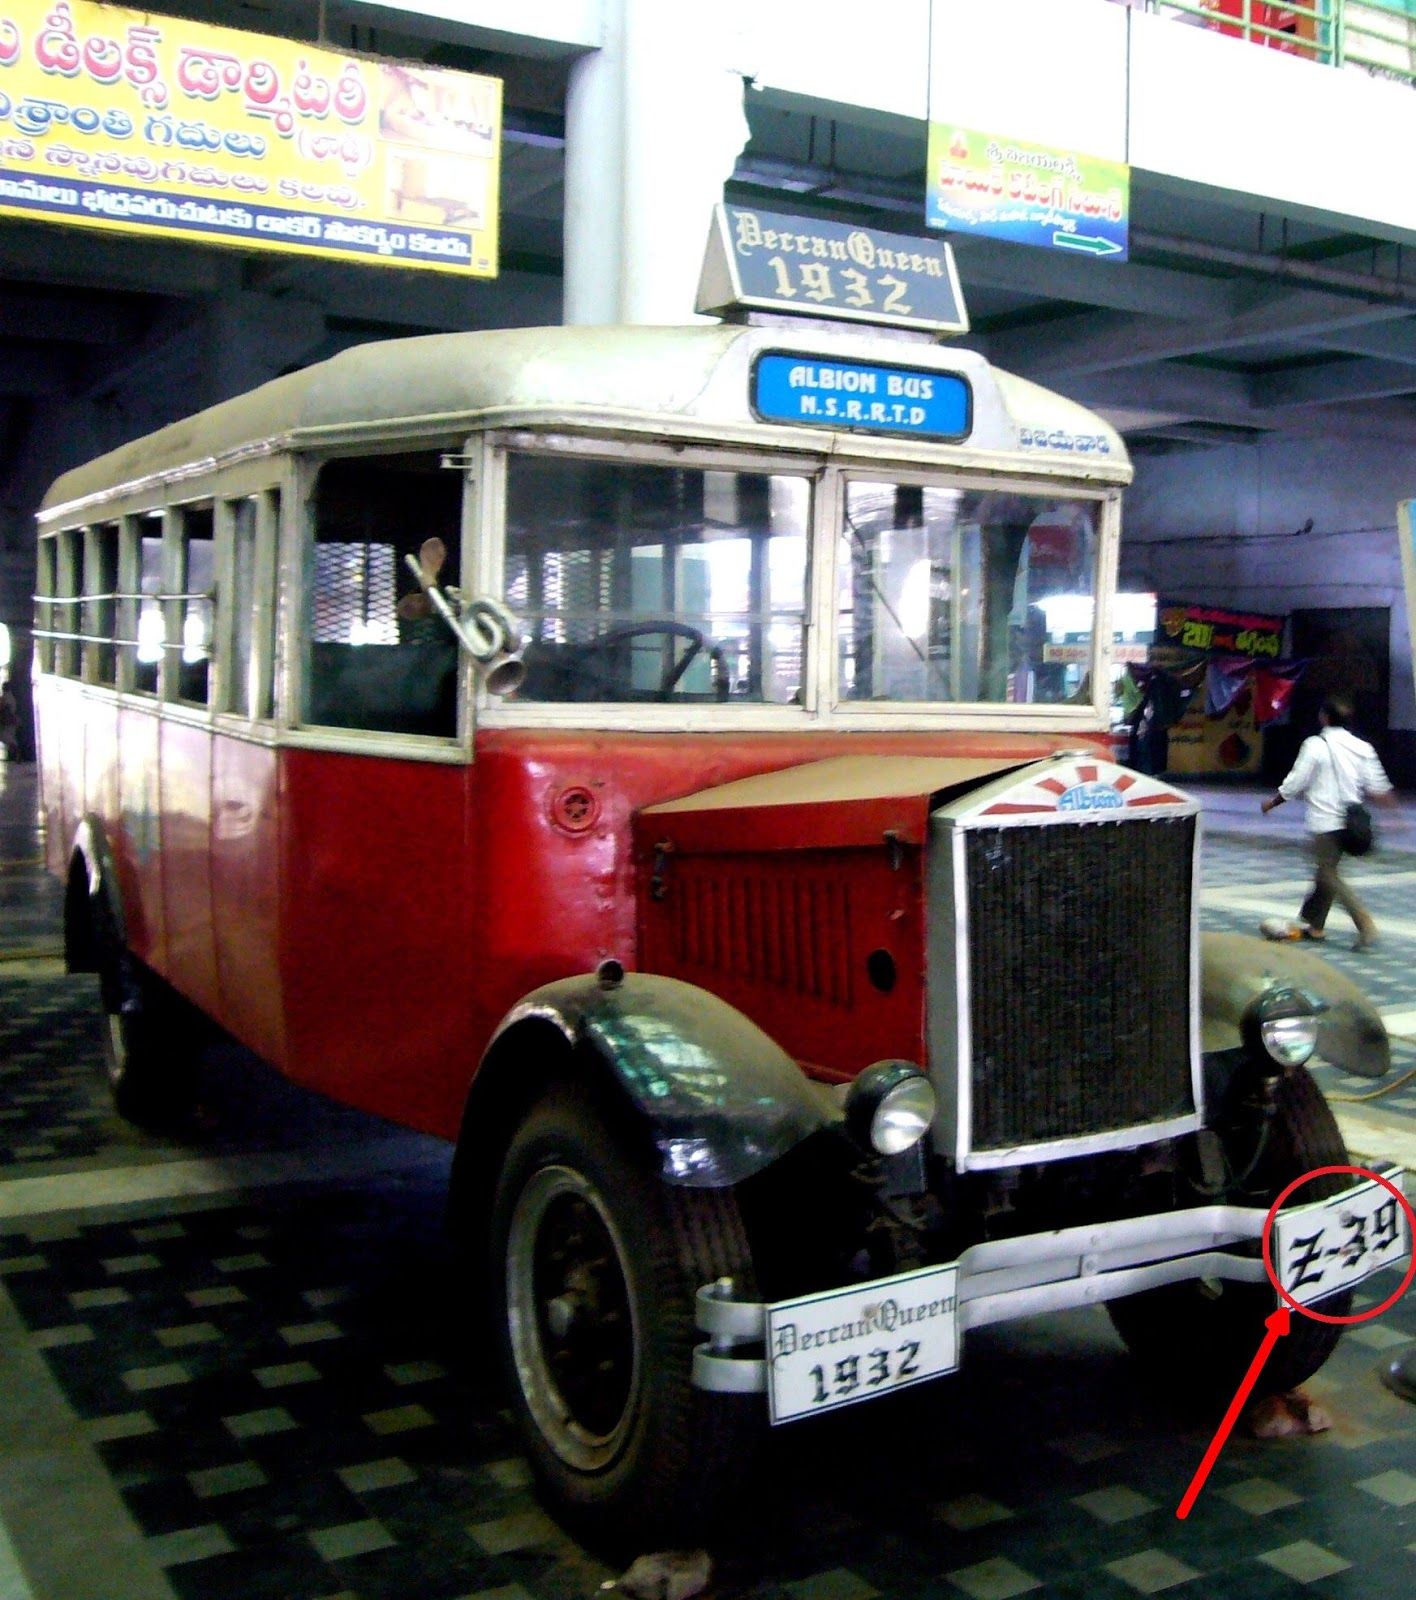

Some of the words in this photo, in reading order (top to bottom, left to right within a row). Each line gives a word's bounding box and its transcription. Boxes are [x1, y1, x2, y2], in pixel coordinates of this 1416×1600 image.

[35, 2, 168, 107] డీలక్స్
[178, 47, 366, 135] డార్మిటరీ
[144, 115, 266, 157] గదులు
[768, 256, 913, 314] 1932
[789, 366, 876, 393] ALBION
[887, 375, 933, 399] BUS
[1288, 1197, 1399, 1292] Z-39
[809, 1341, 921, 1402] 1932
